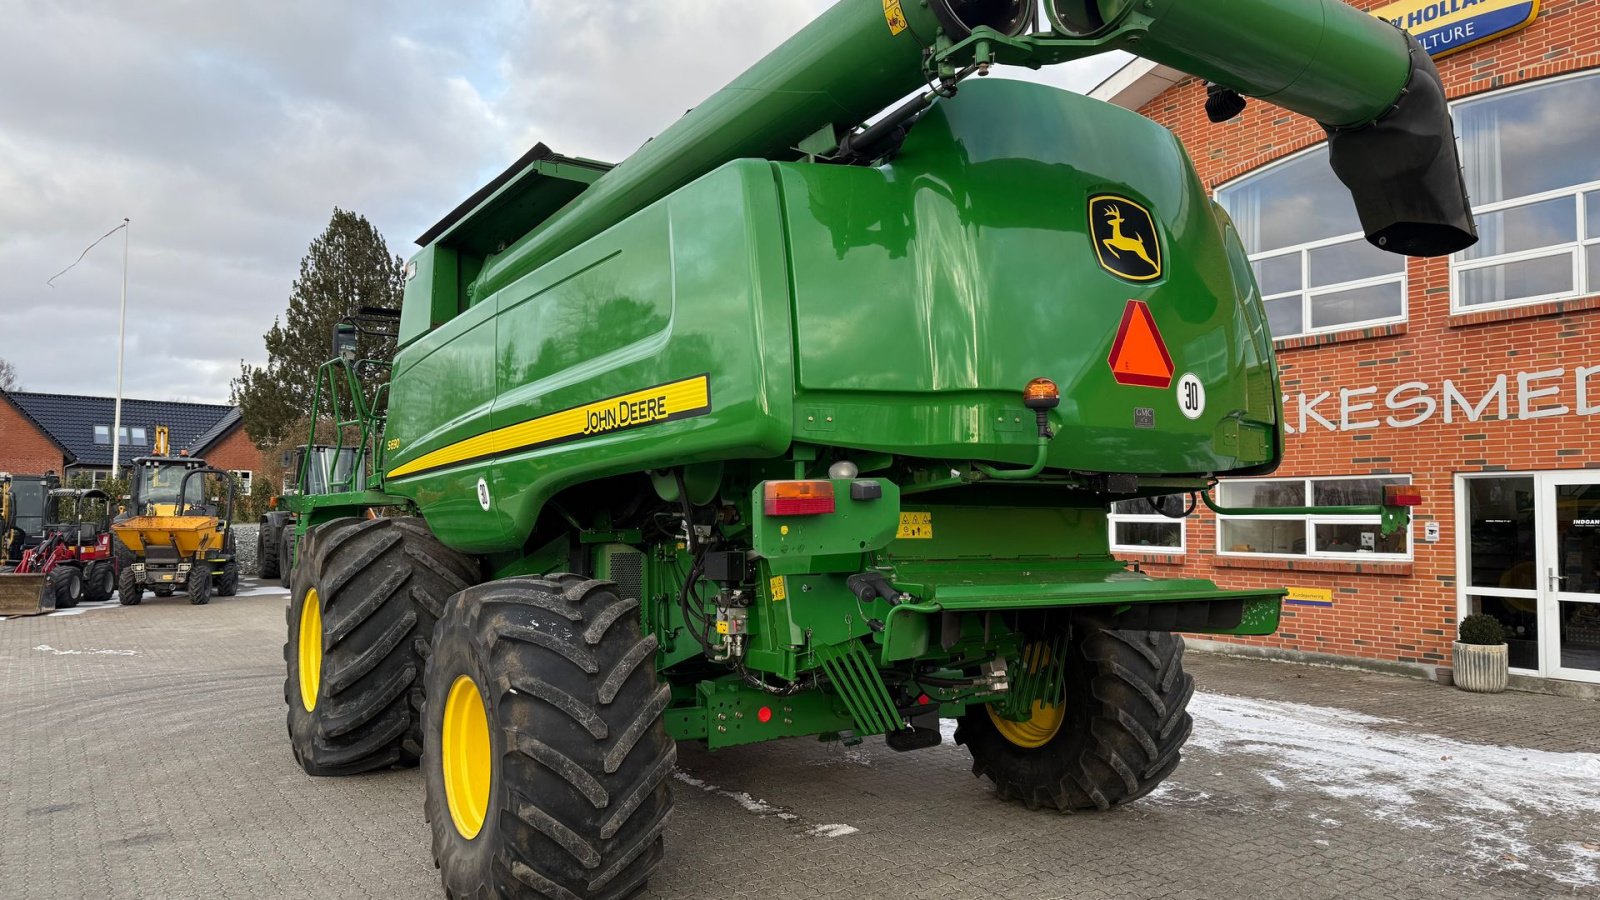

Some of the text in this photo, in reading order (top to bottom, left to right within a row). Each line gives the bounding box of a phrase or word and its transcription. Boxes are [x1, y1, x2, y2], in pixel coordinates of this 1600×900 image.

[1407, 0, 1486, 29] HOLLA
[1184, 381, 1198, 411] 30
[584, 396, 667, 432] JOHN DEERE
[387, 438, 400, 451] S690
[480, 484, 488, 505] 30
